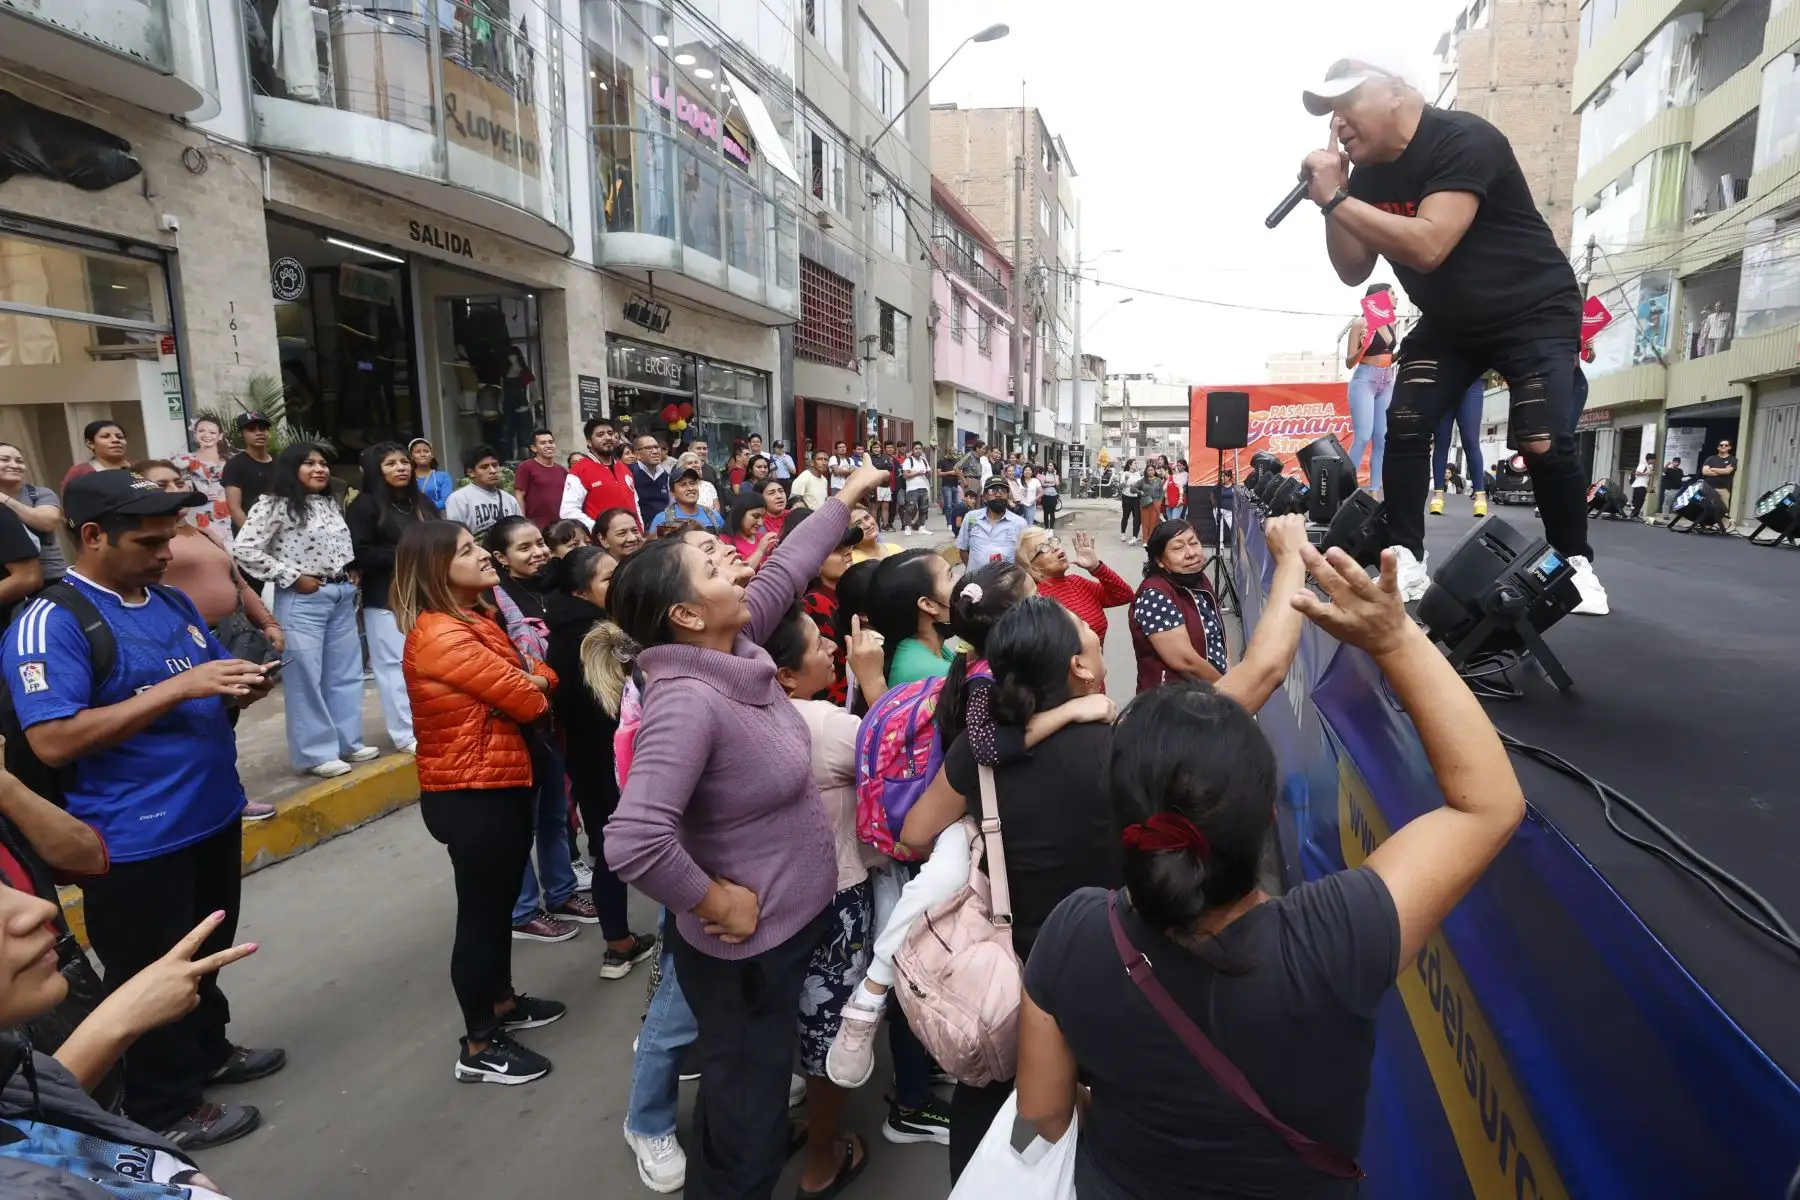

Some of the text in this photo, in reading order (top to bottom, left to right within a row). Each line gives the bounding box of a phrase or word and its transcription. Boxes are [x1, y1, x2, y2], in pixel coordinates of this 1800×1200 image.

[408, 219, 474, 259] SALIDA
[1269, 402, 1335, 419] PASARELA
[1247, 416, 1354, 445] gamarr
[1268, 434, 1320, 454] Stre
